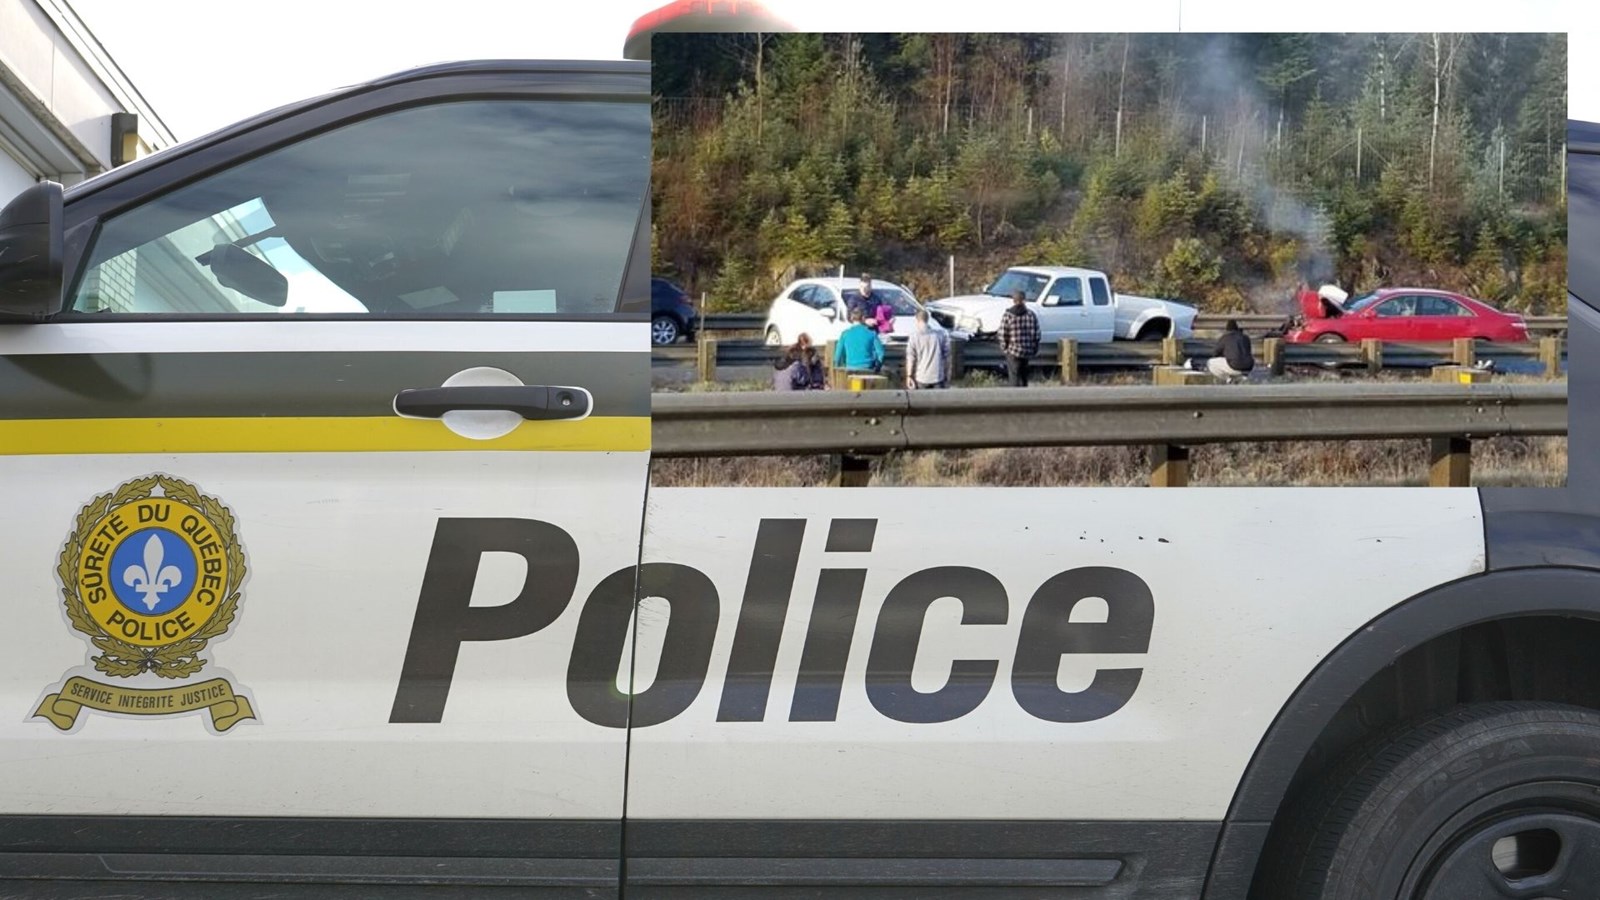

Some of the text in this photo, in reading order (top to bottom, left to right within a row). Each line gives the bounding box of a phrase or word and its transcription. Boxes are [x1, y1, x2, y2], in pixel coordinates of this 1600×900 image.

[82, 504, 222, 606] SÛRETÉ DU QUÉBEC
[106, 611, 195, 640] POLICE
[388, 517, 1156, 729] Police
[71, 683, 113, 704] SERVICE
[181, 684, 225, 706] JUSTICE
